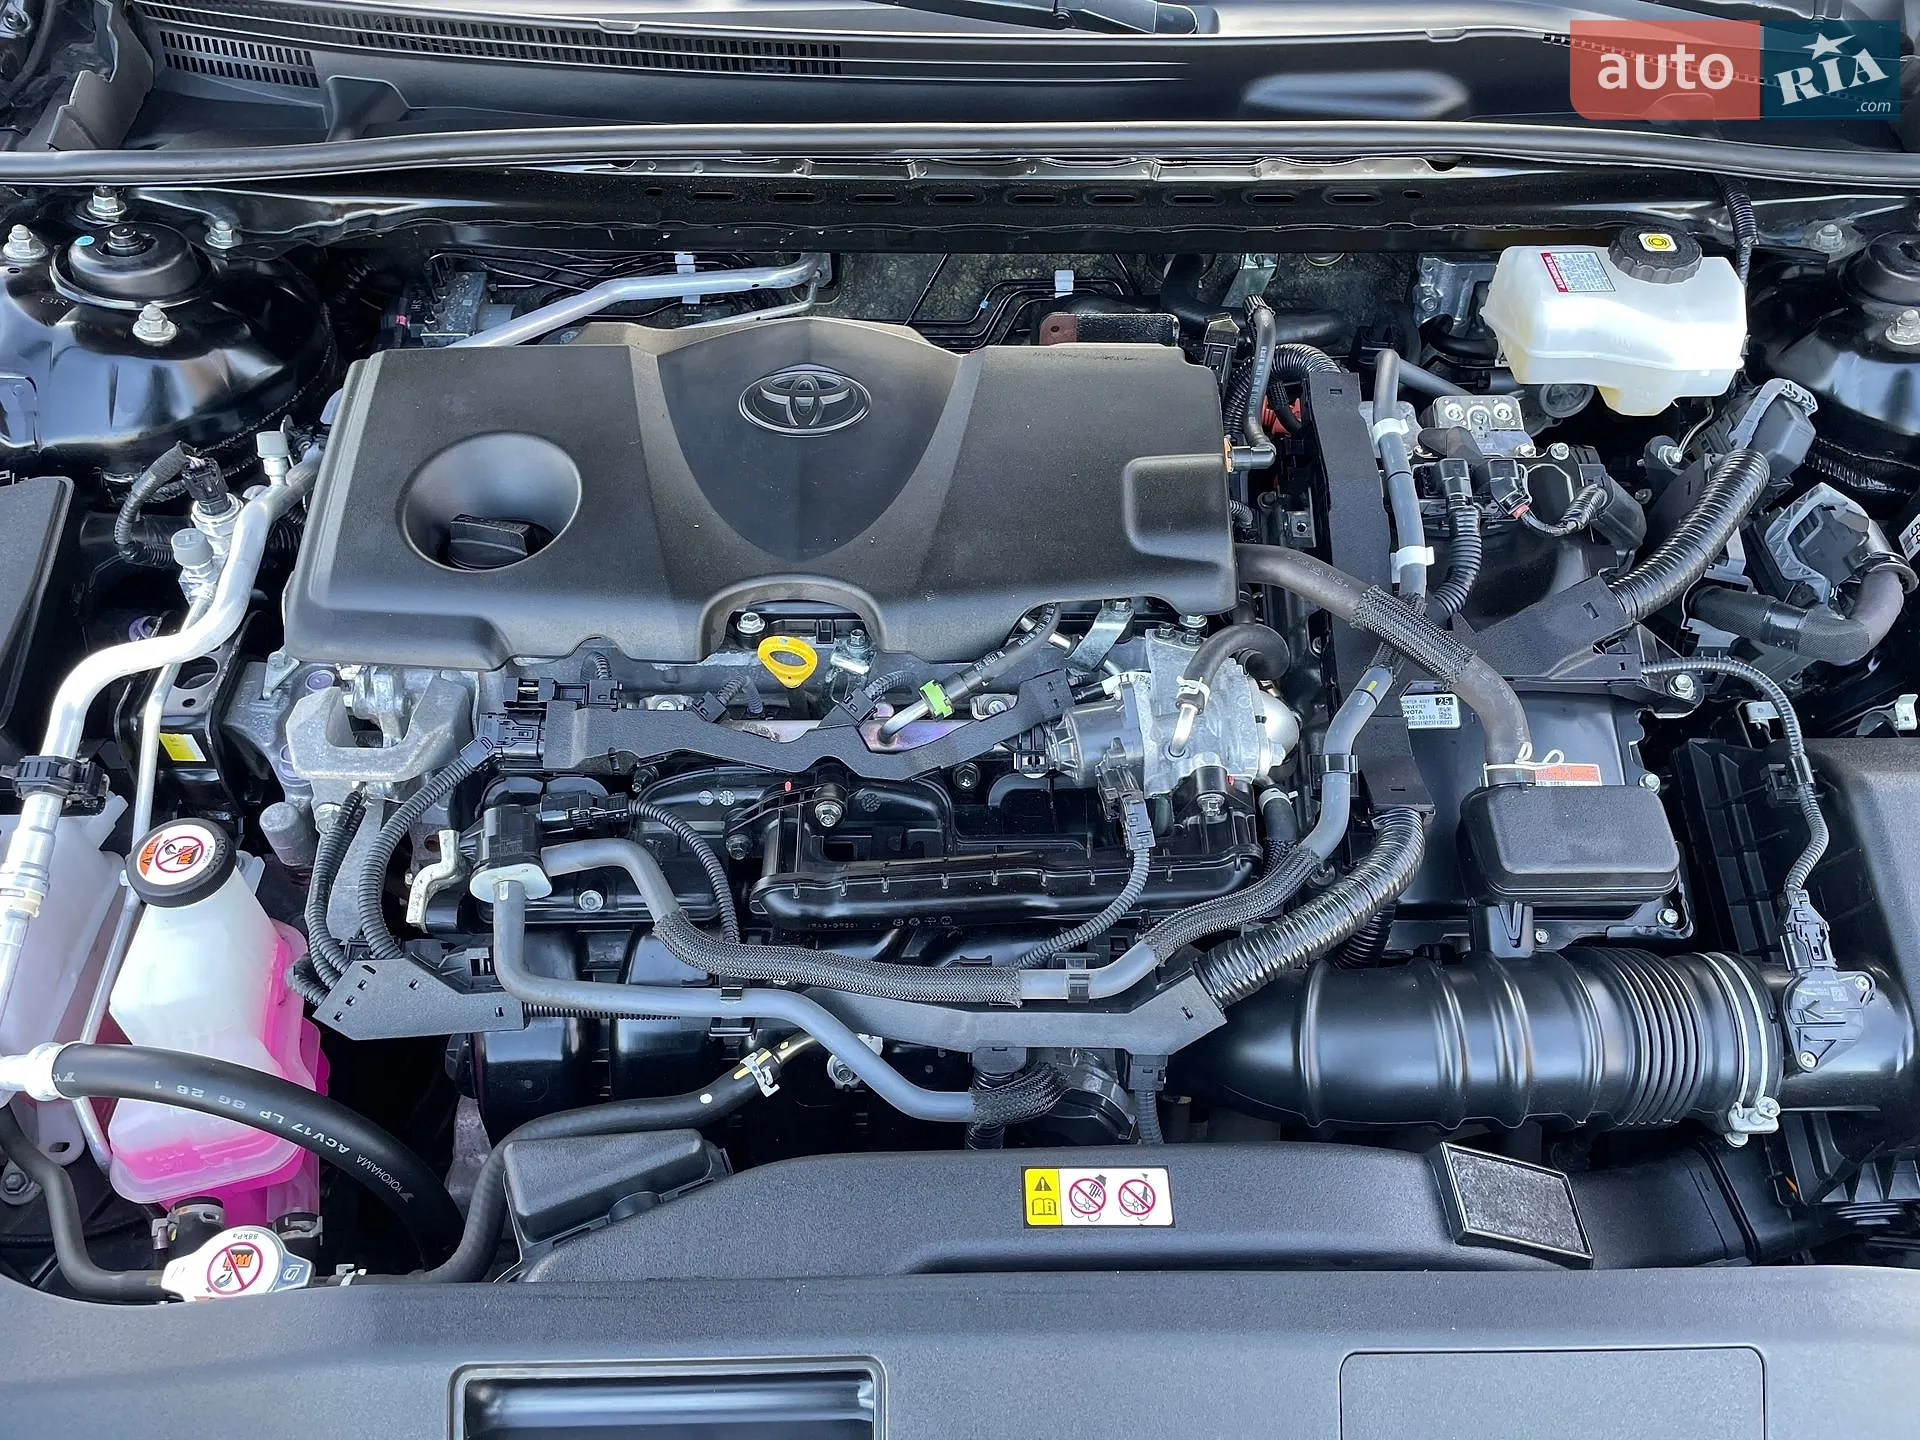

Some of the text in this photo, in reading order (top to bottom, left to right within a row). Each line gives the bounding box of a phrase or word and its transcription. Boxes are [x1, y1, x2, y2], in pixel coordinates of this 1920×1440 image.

[1438, 697, 1450, 705] 25
[259, 1110, 285, 1124] LP
[291, 1123, 350, 1154] ACV17
[356, 1153, 403, 1193] YOKOHAMA
